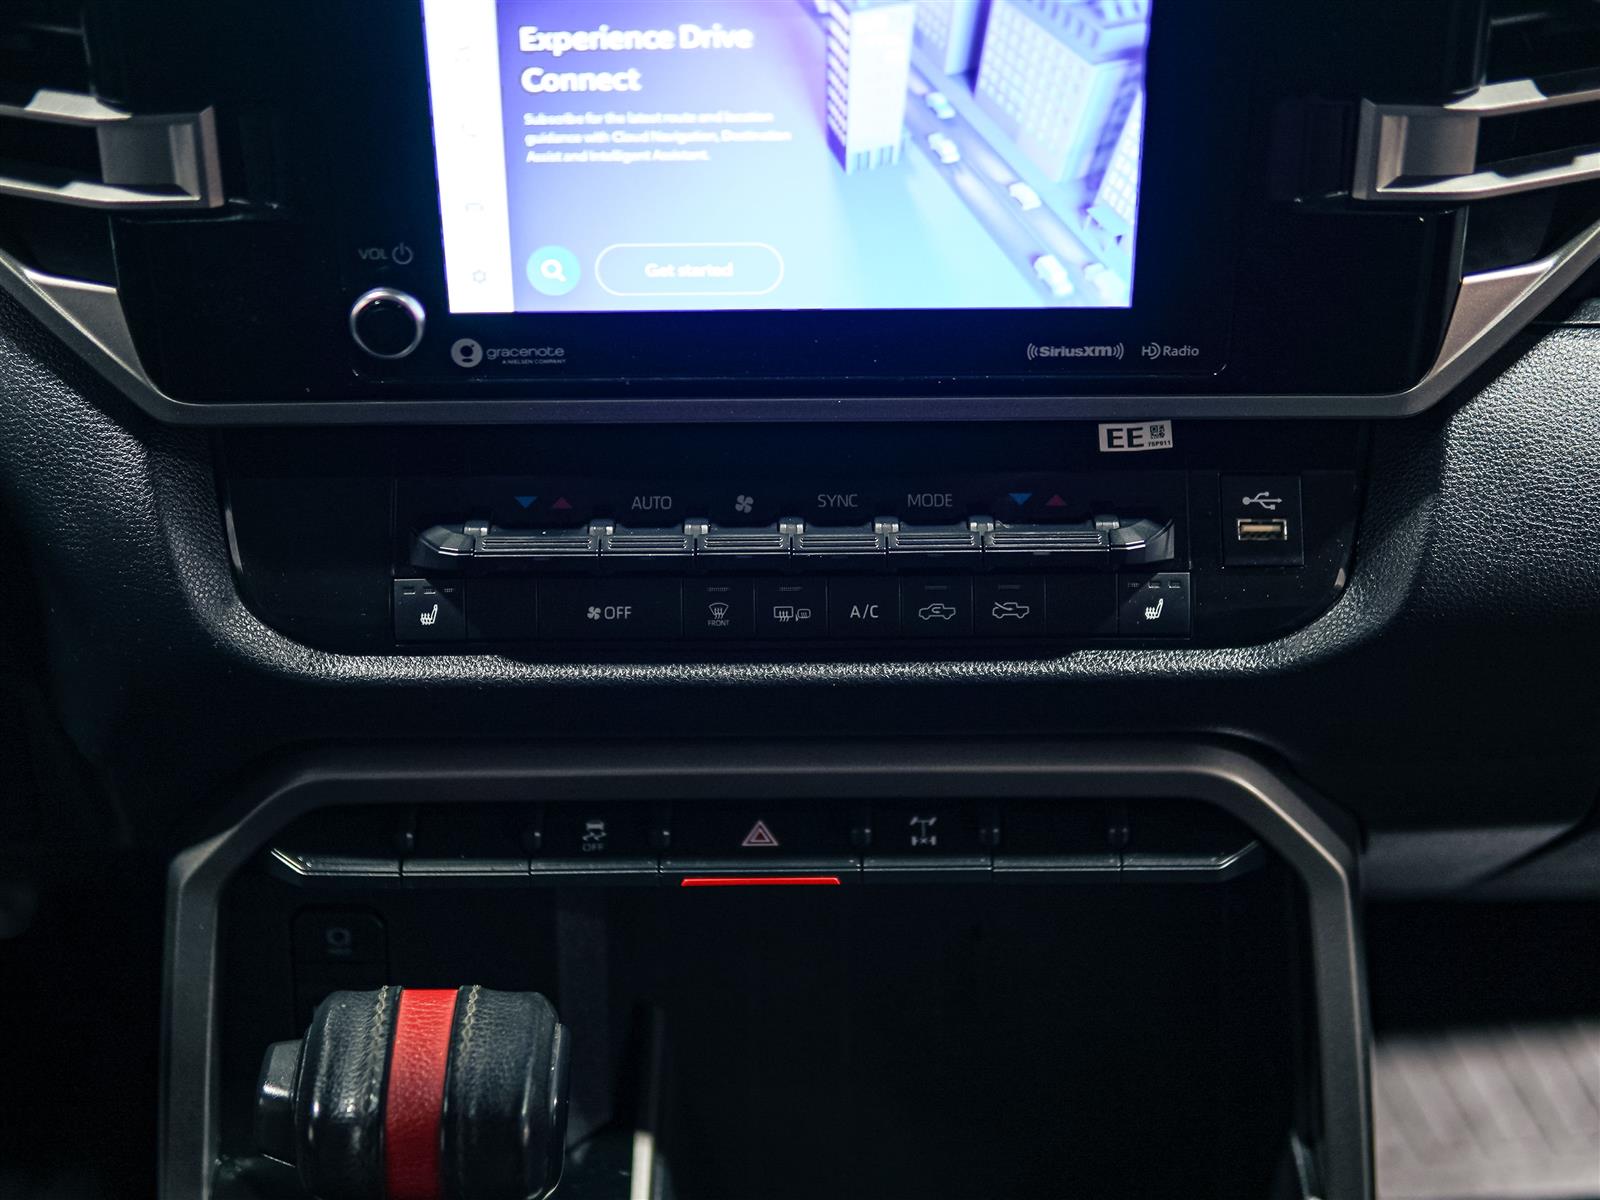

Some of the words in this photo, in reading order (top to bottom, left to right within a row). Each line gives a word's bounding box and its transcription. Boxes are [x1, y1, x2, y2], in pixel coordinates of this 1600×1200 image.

[519, 24, 675, 57] Experience
[678, 22, 754, 50] Drive
[521, 66, 643, 92] Connect
[358, 247, 388, 260] VOL
[644, 262, 674, 278] Get
[676, 261, 734, 278] started
[486, 346, 566, 360] gracenote
[1163, 345, 1200, 357] Radio
[1106, 426, 1144, 449] EE
[631, 495, 673, 511] AUTO
[817, 493, 859, 508] SYNC
[907, 493, 953, 508] MODE
[604, 605, 632, 620] OFF
[850, 604, 879, 620] A/C
[707, 619, 730, 627] FRONT
[582, 842, 605, 853] OFF
